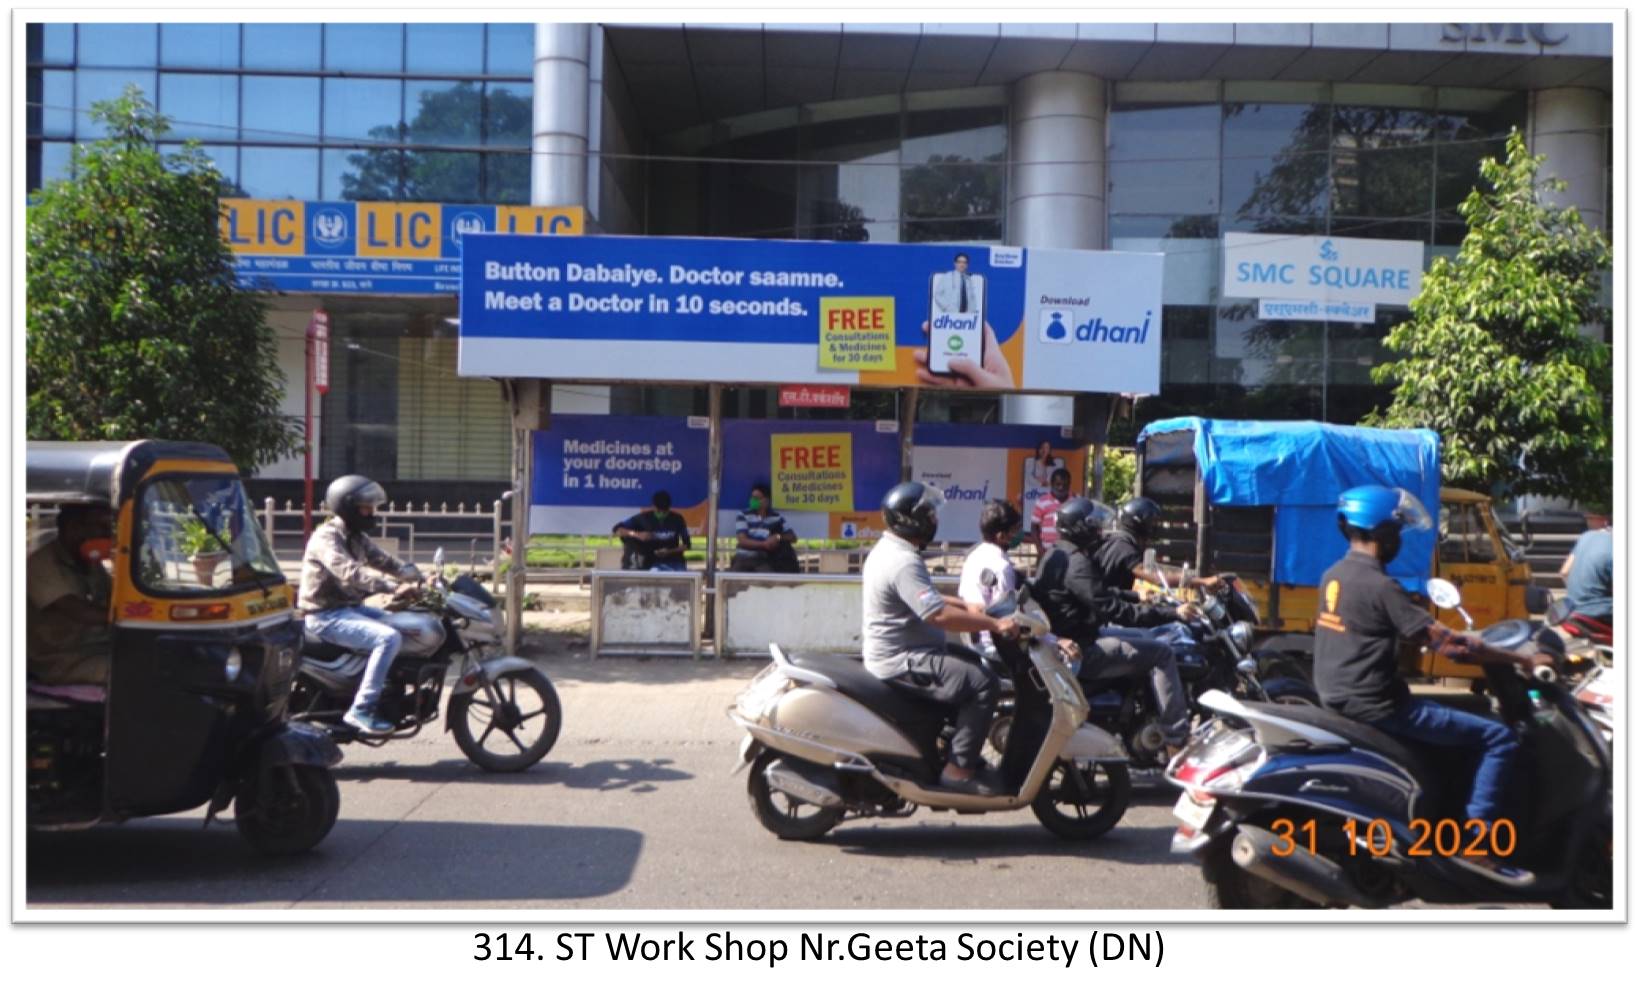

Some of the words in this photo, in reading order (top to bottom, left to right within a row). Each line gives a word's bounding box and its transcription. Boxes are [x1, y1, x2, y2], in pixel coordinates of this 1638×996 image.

[229, 208, 296, 246] LIC
[367, 210, 432, 249] LIC
[484, 261, 560, 282] Button
[566, 263, 664, 287] Dabaiye.
[669, 265, 744, 286] Doctor
[749, 270, 845, 288] saamne.
[1236, 262, 1296, 285] SMC
[1308, 264, 1410, 291] SQUARE
[484, 291, 543, 311] Meet
[548, 296, 562, 311] a
[568, 293, 643, 313] Doctor
[649, 294, 669, 313] in
[676, 296, 704, 314] 10
[708, 297, 809, 316] seconds.
[1040, 294, 1091, 306] Download
[828, 307, 885, 331] FREE
[933, 310, 979, 330] dhani
[1075, 310, 1153, 344] dhani
[825, 332, 890, 342] Consultations
[829, 344, 838, 352] &
[839, 343, 888, 352] Medicines
[833, 353, 846, 363] for
[863, 353, 883, 363] days
[563, 439, 652, 456] Medicines
[655, 441, 674, 456] at
[563, 457, 601, 472] your
[604, 456, 683, 474] doorstep
[780, 445, 841, 470] FREE
[563, 473, 580, 488] in
[584, 473, 595, 489] 1
[599, 474, 642, 489] hour.
[777, 470, 847, 481] Consultations
[782, 483, 790, 493] &
[792, 482, 844, 492] Medicines
[944, 480, 989, 500] dhani
[786, 494, 800, 504] for
[802, 494, 815, 503] 30
[817, 493, 840, 504] days
